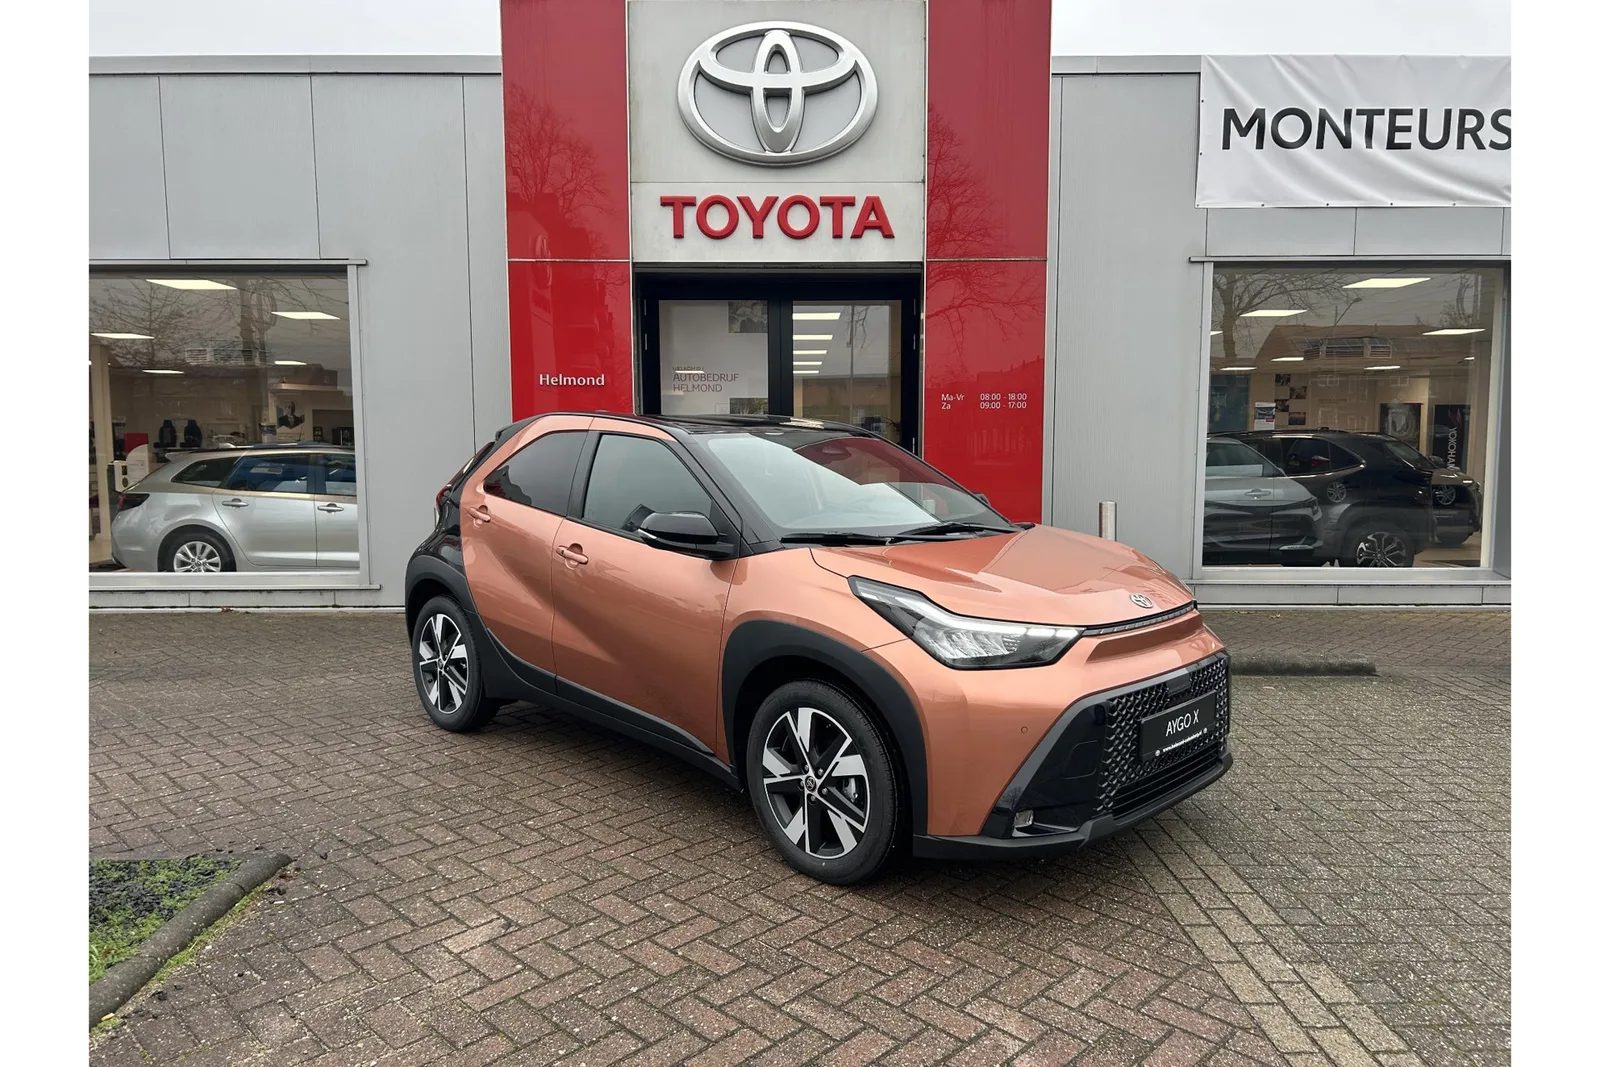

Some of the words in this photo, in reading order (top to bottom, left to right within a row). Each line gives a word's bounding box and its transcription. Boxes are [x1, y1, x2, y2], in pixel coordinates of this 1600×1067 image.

[1221, 107, 1511, 150] MONTEURS
[660, 194, 895, 240] TOYOTA
[539, 373, 605, 386] Helmond
[672, 373, 740, 382] AUTOBEDRIJF
[673, 383, 723, 393] HELMOND
[941, 393, 965, 401] Ma-Vr
[980, 393, 1001, 401] 08:00
[1008, 392, 1027, 400] 18:00
[941, 402, 951, 410] Za
[980, 401, 1001, 409] 09:00
[1008, 401, 1027, 409] 17:00
[1165, 713, 1192, 737] AYGO
[1193, 709, 1199, 724] X
